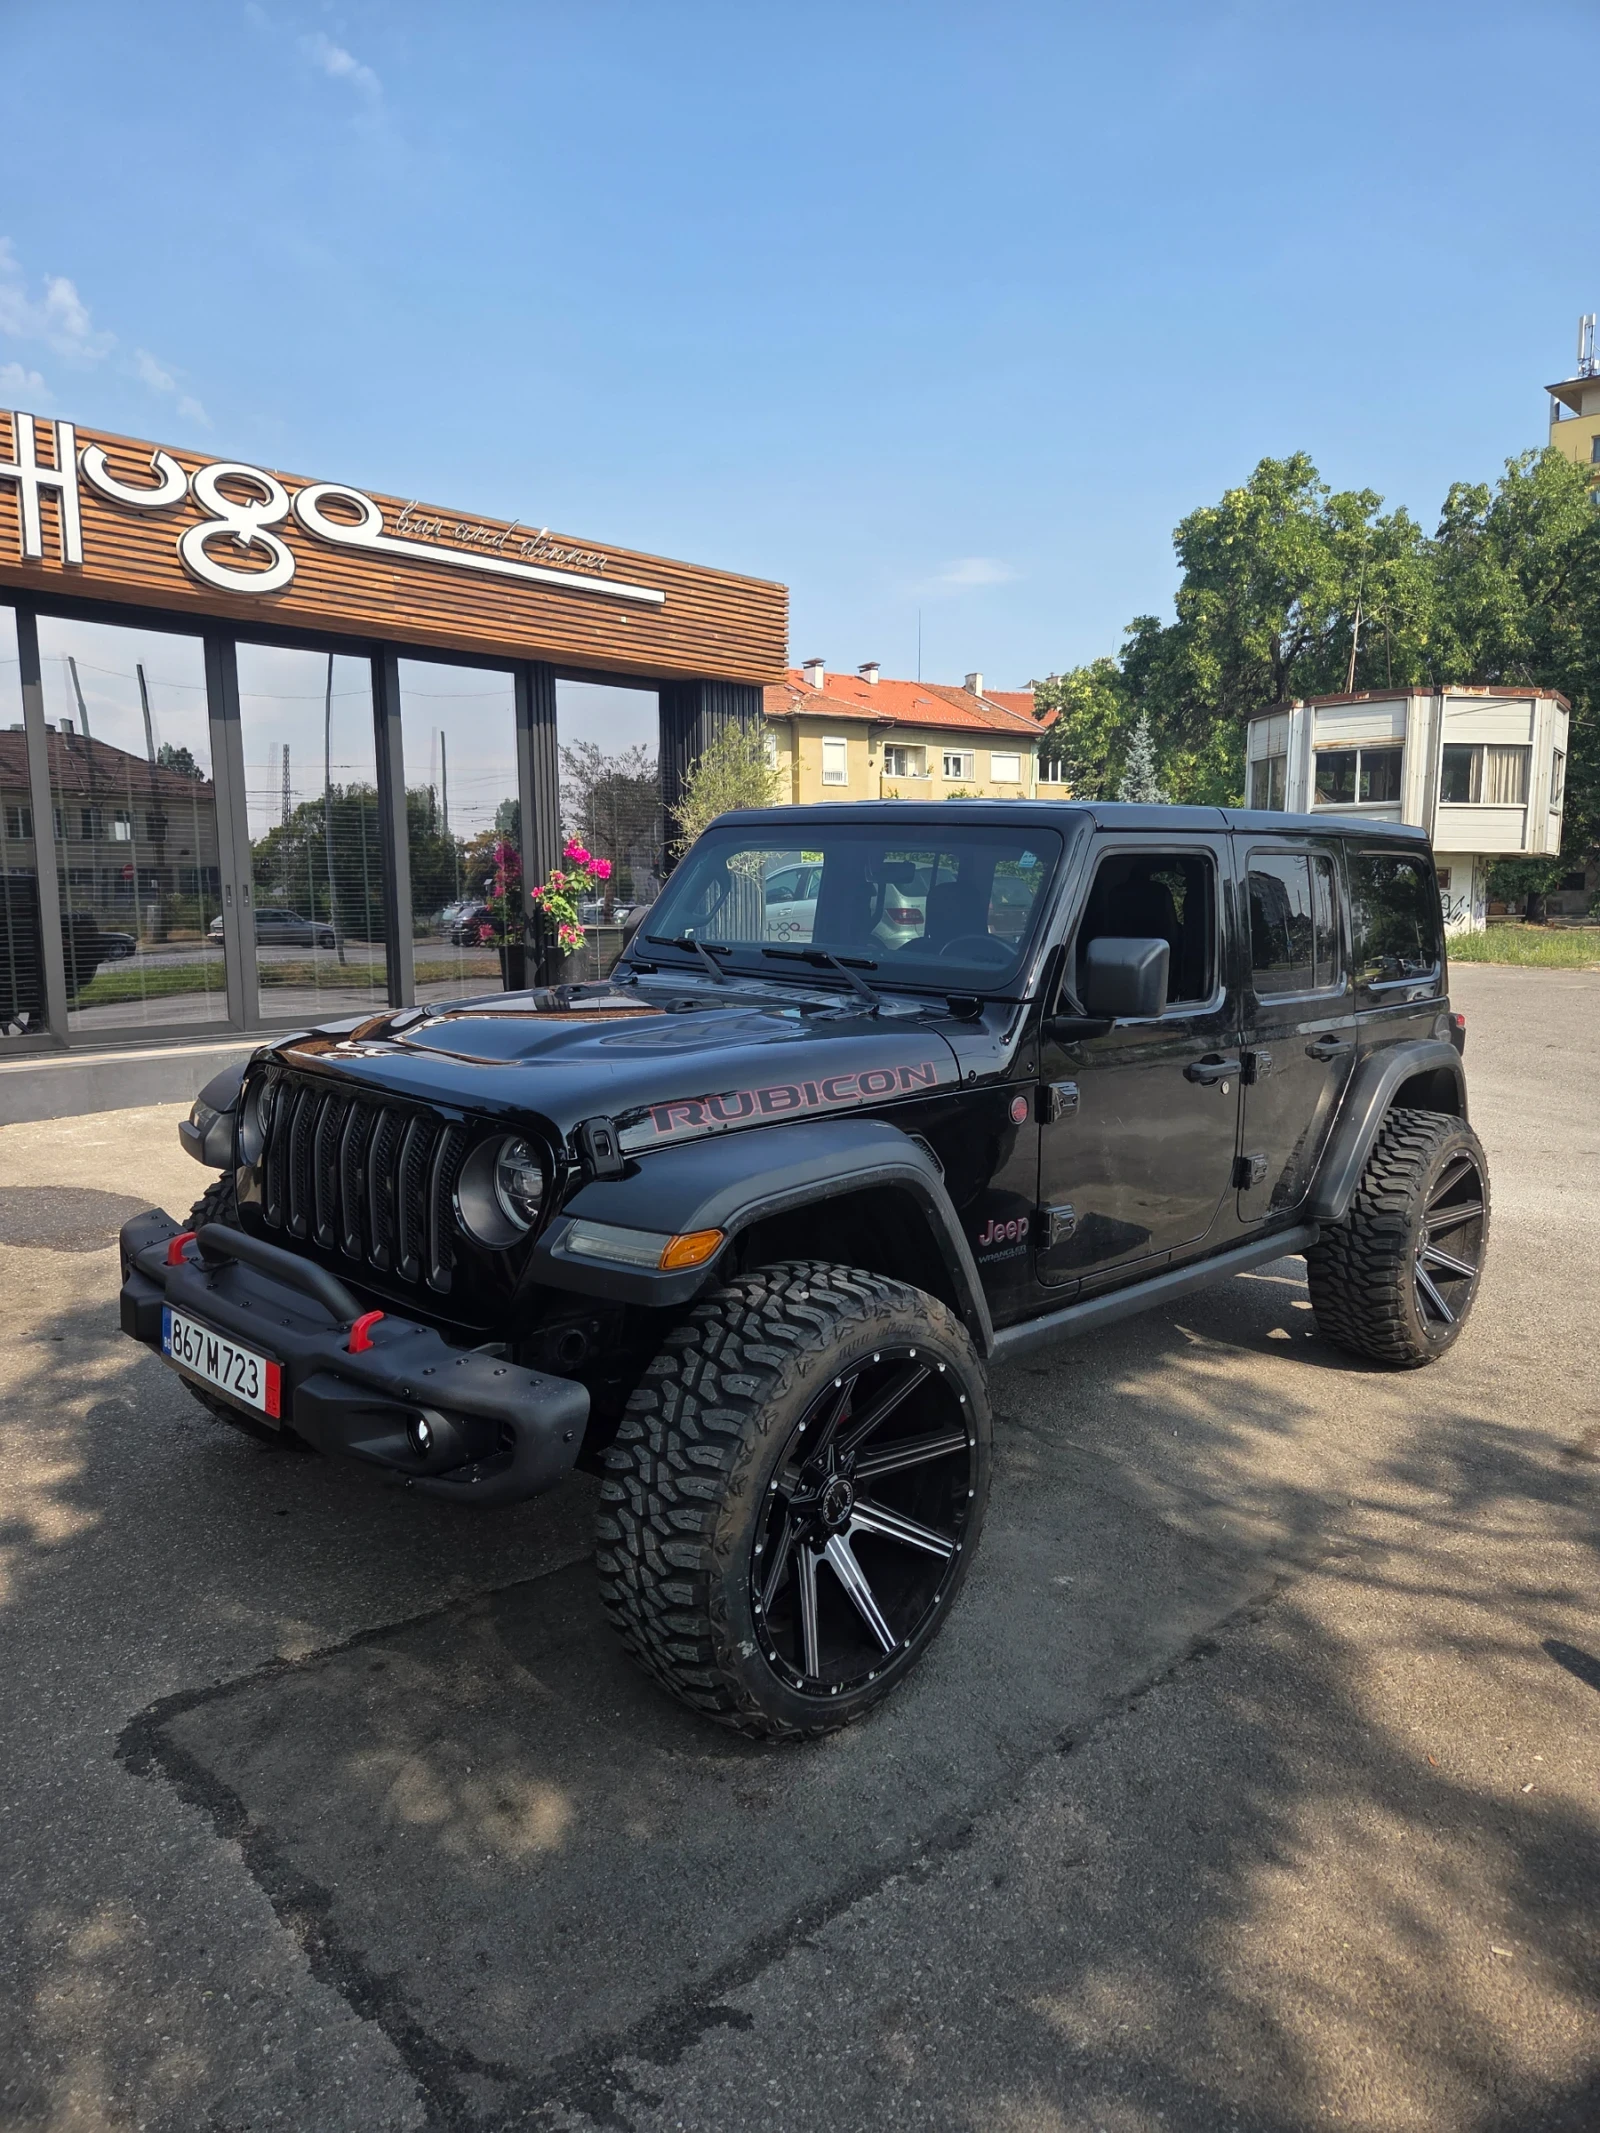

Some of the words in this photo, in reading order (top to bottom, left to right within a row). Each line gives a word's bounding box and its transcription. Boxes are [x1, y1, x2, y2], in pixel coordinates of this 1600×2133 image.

[0, 410, 386, 595] Hugo
[396, 500, 442, 536] bar
[455, 519, 519, 549] and
[520, 526, 608, 570] dinner
[650, 1062, 937, 1135] RUBICON
[979, 1217, 1029, 1246] Jeep
[979, 1245, 1027, 1264] WRANGLER
